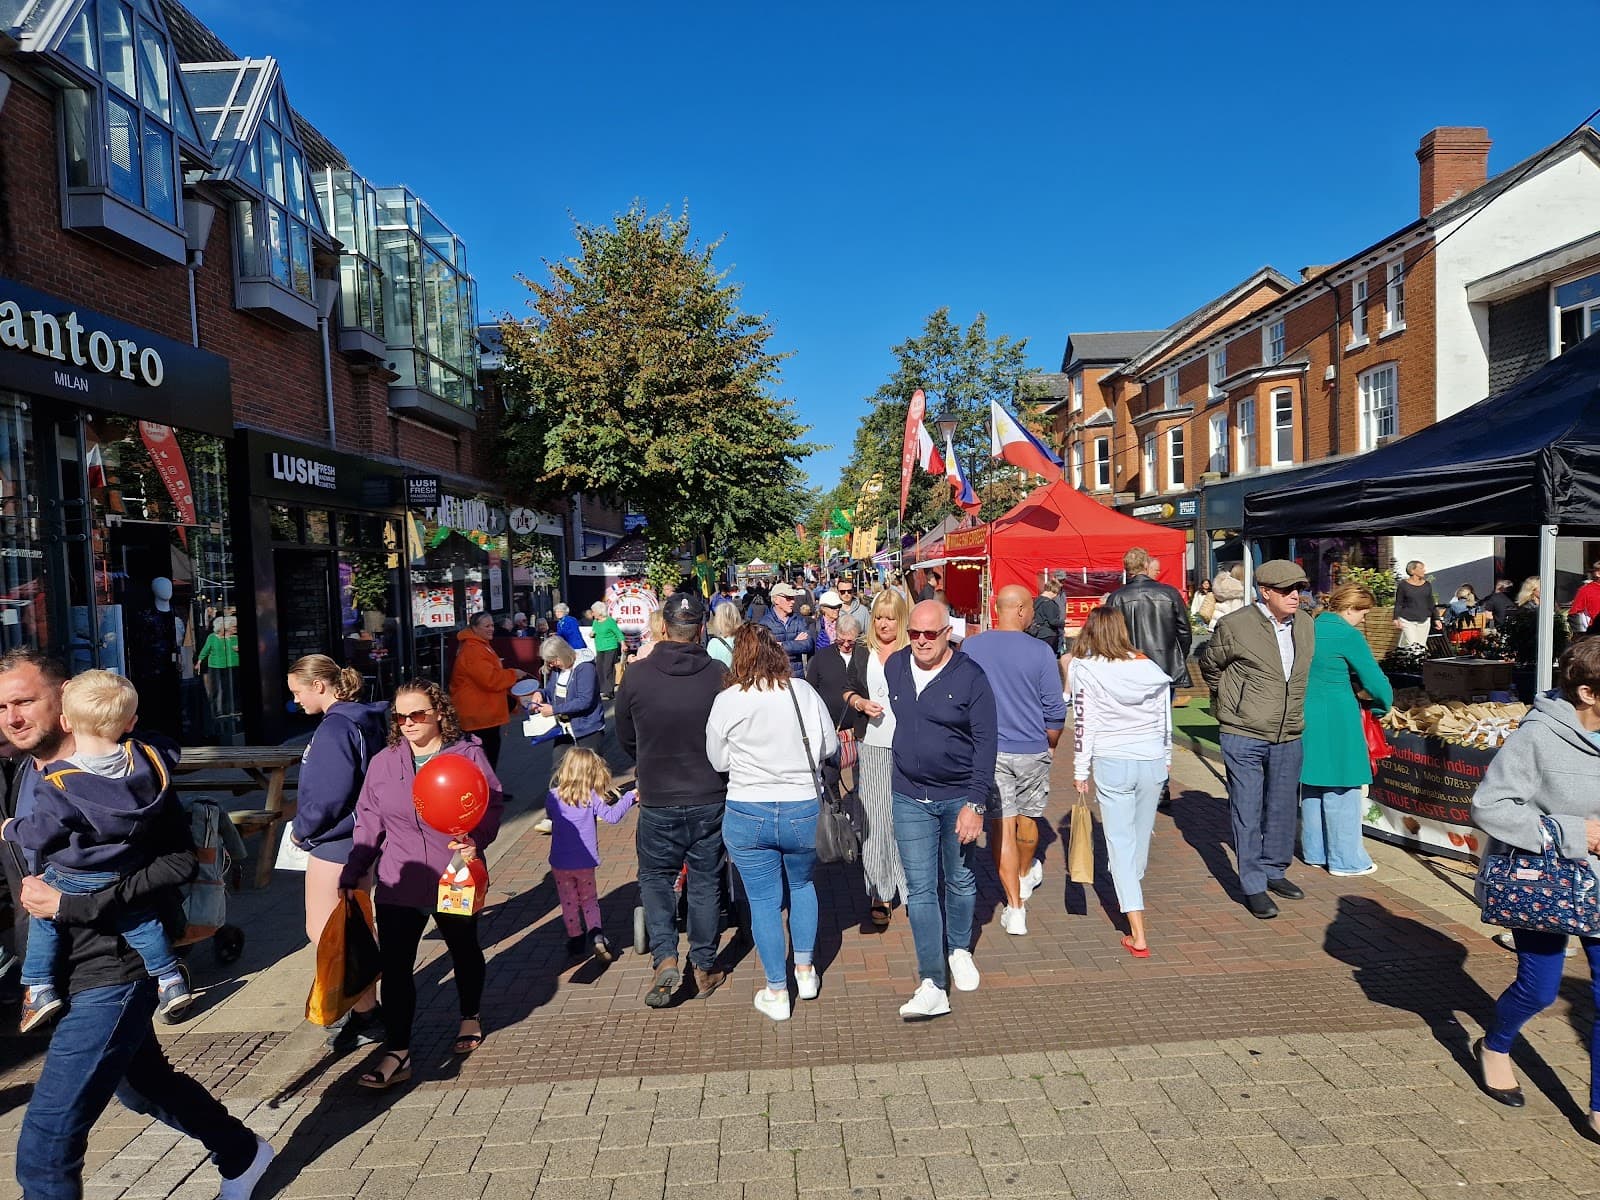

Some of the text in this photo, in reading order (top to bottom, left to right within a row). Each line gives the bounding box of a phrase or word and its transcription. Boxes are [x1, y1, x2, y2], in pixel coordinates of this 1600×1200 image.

[0, 301, 164, 387] antoro
[54, 371, 89, 392] MILAN
[272, 452, 320, 486] LUSH
[409, 479, 437, 487] LUSH
[1391, 745, 1440, 768] Authentic
[1443, 759, 1480, 777] Indian
[1444, 775, 1471, 790] 07833
[1386, 790, 1410, 809] TRUE
[1413, 799, 1448, 818] TASTE
[1449, 807, 1470, 821] OF
